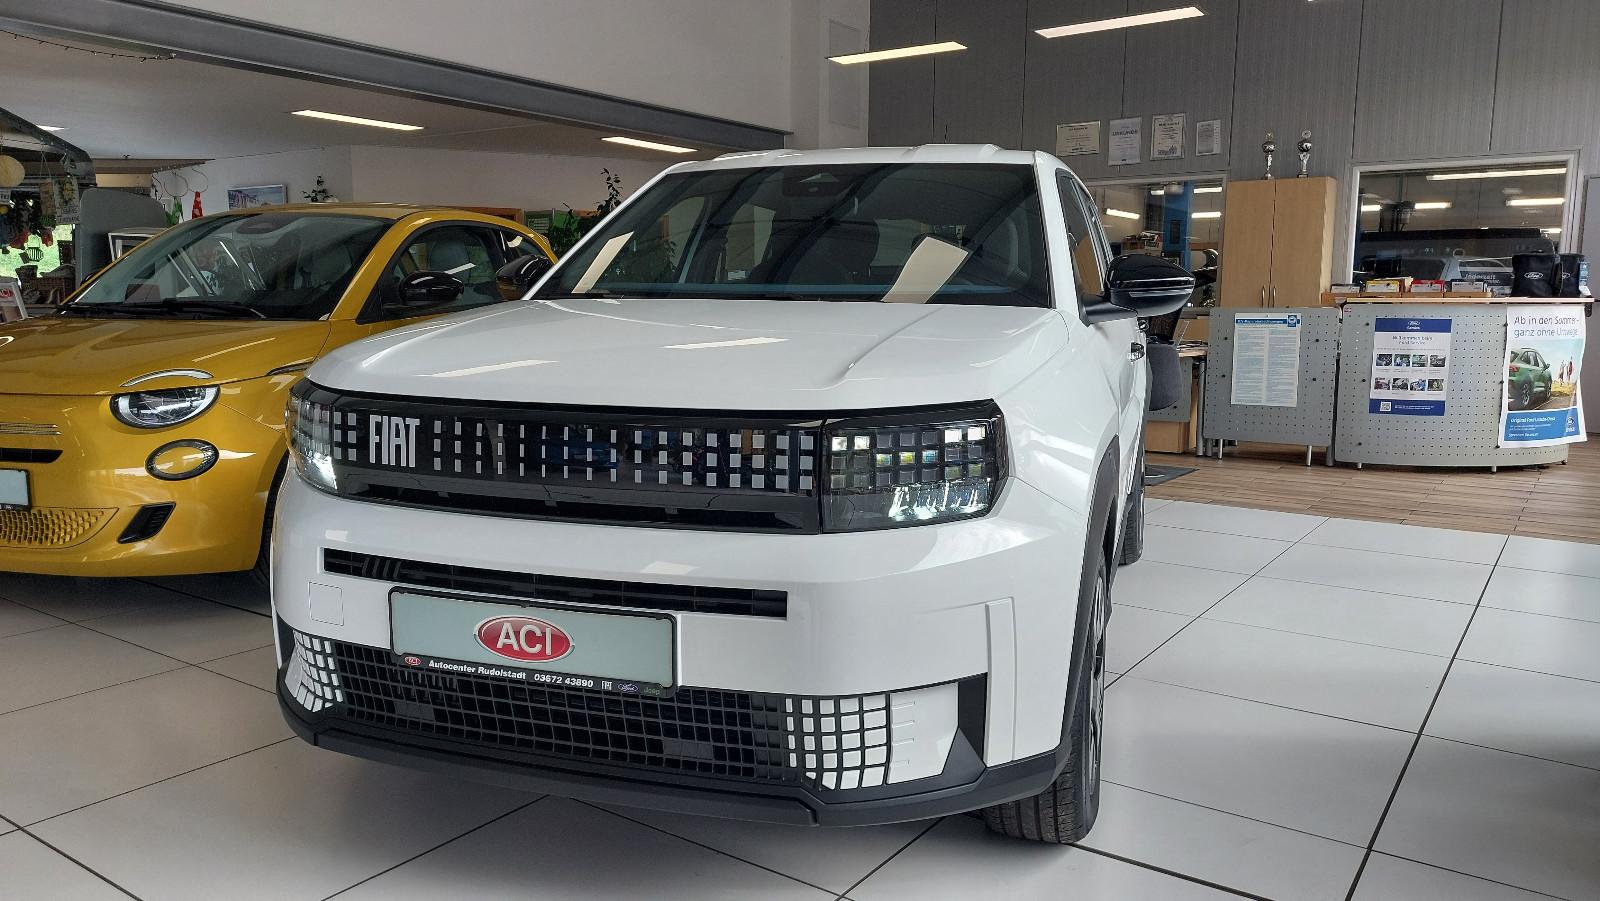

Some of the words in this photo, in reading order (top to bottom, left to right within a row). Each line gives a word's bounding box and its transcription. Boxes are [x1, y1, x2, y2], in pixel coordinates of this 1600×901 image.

[1514, 316, 1526, 325] Ab
[1528, 316, 1537, 325] in
[1513, 329, 1535, 338] ganz
[369, 414, 420, 468] FIAT
[496, 622, 552, 656] ACI
[428, 659, 476, 673] Autocenter
[478, 666, 527, 680] Rudolstadt
[534, 673, 563, 684] 03672
[564, 677, 594, 688] 43890
[601, 681, 613, 690] FIAT
